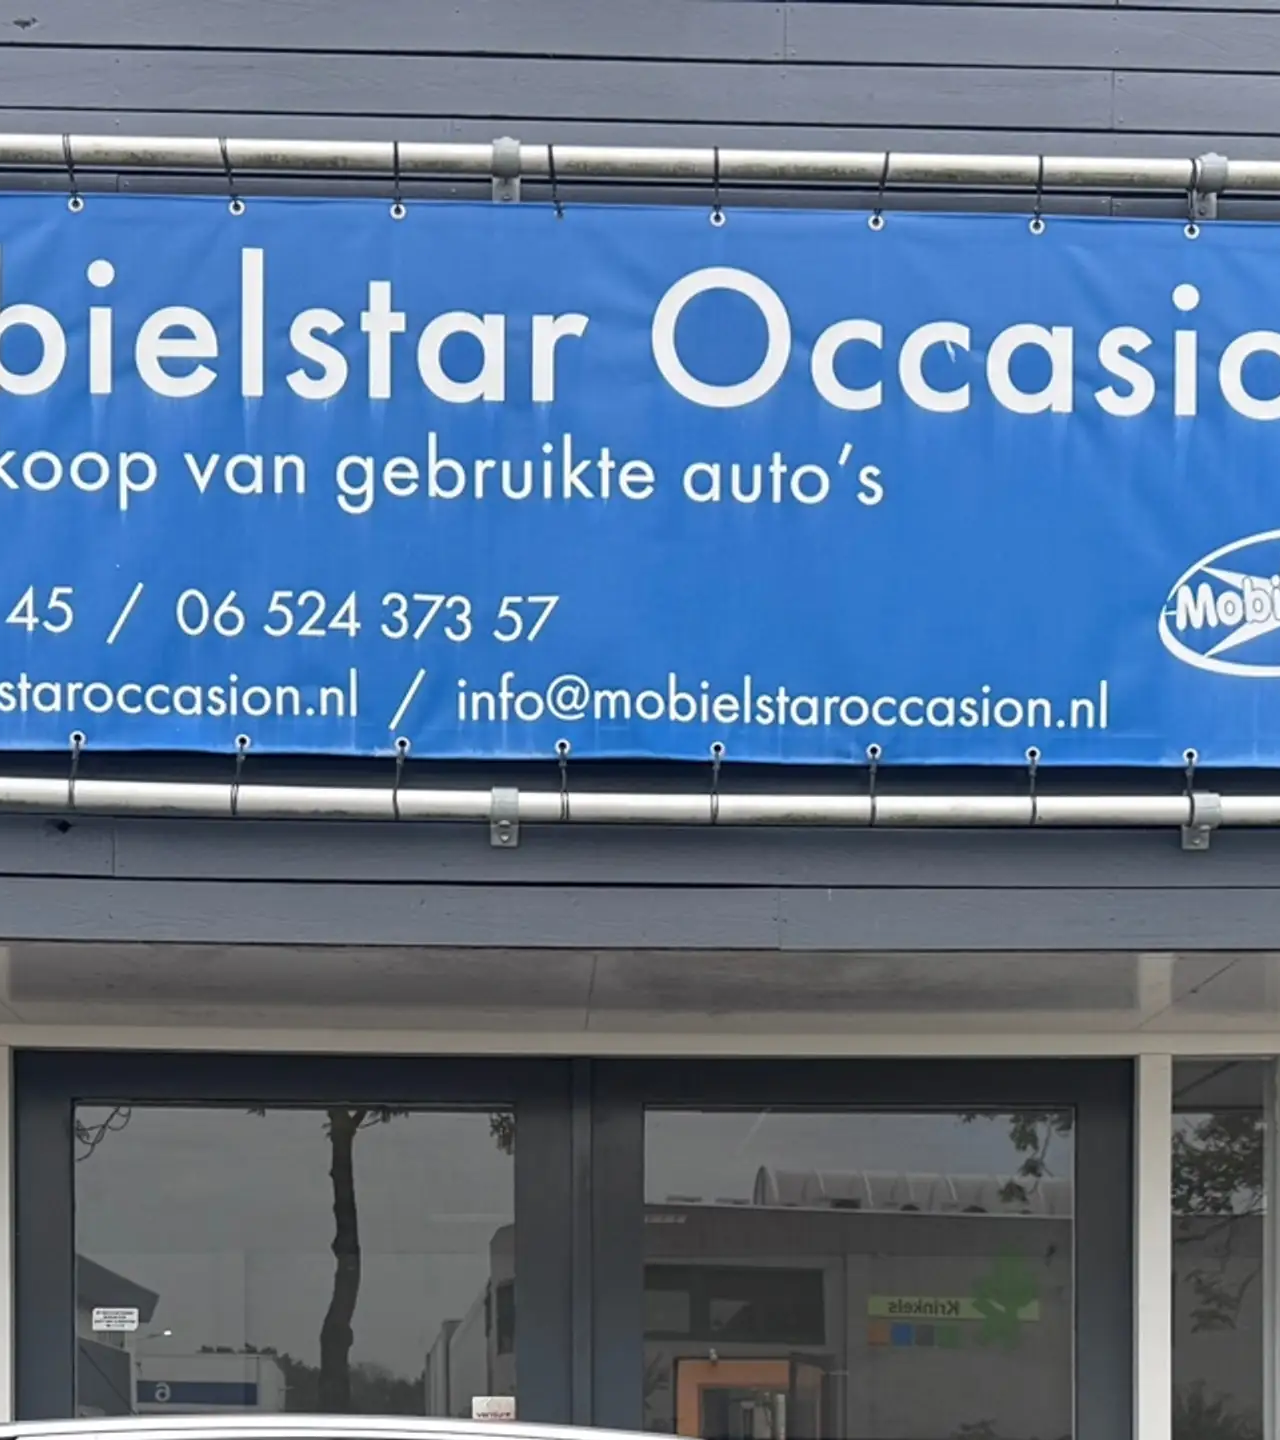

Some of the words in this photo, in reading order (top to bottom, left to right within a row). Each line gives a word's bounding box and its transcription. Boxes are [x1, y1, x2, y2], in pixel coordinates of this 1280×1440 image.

[184, 452, 306, 495] van
[336, 431, 655, 514] gebruikte
[683, 443, 884, 506] auto's
[6, 586, 73, 633] 45
[107, 583, 143, 644] /
[176, 589, 245, 638] 06
[264, 590, 361, 638] 524
[381, 592, 472, 643] 373
[493, 595, 559, 642] 57
[389, 669, 425, 731] /
[458, 671, 1108, 730] info@mobielstaroccasion.nl
